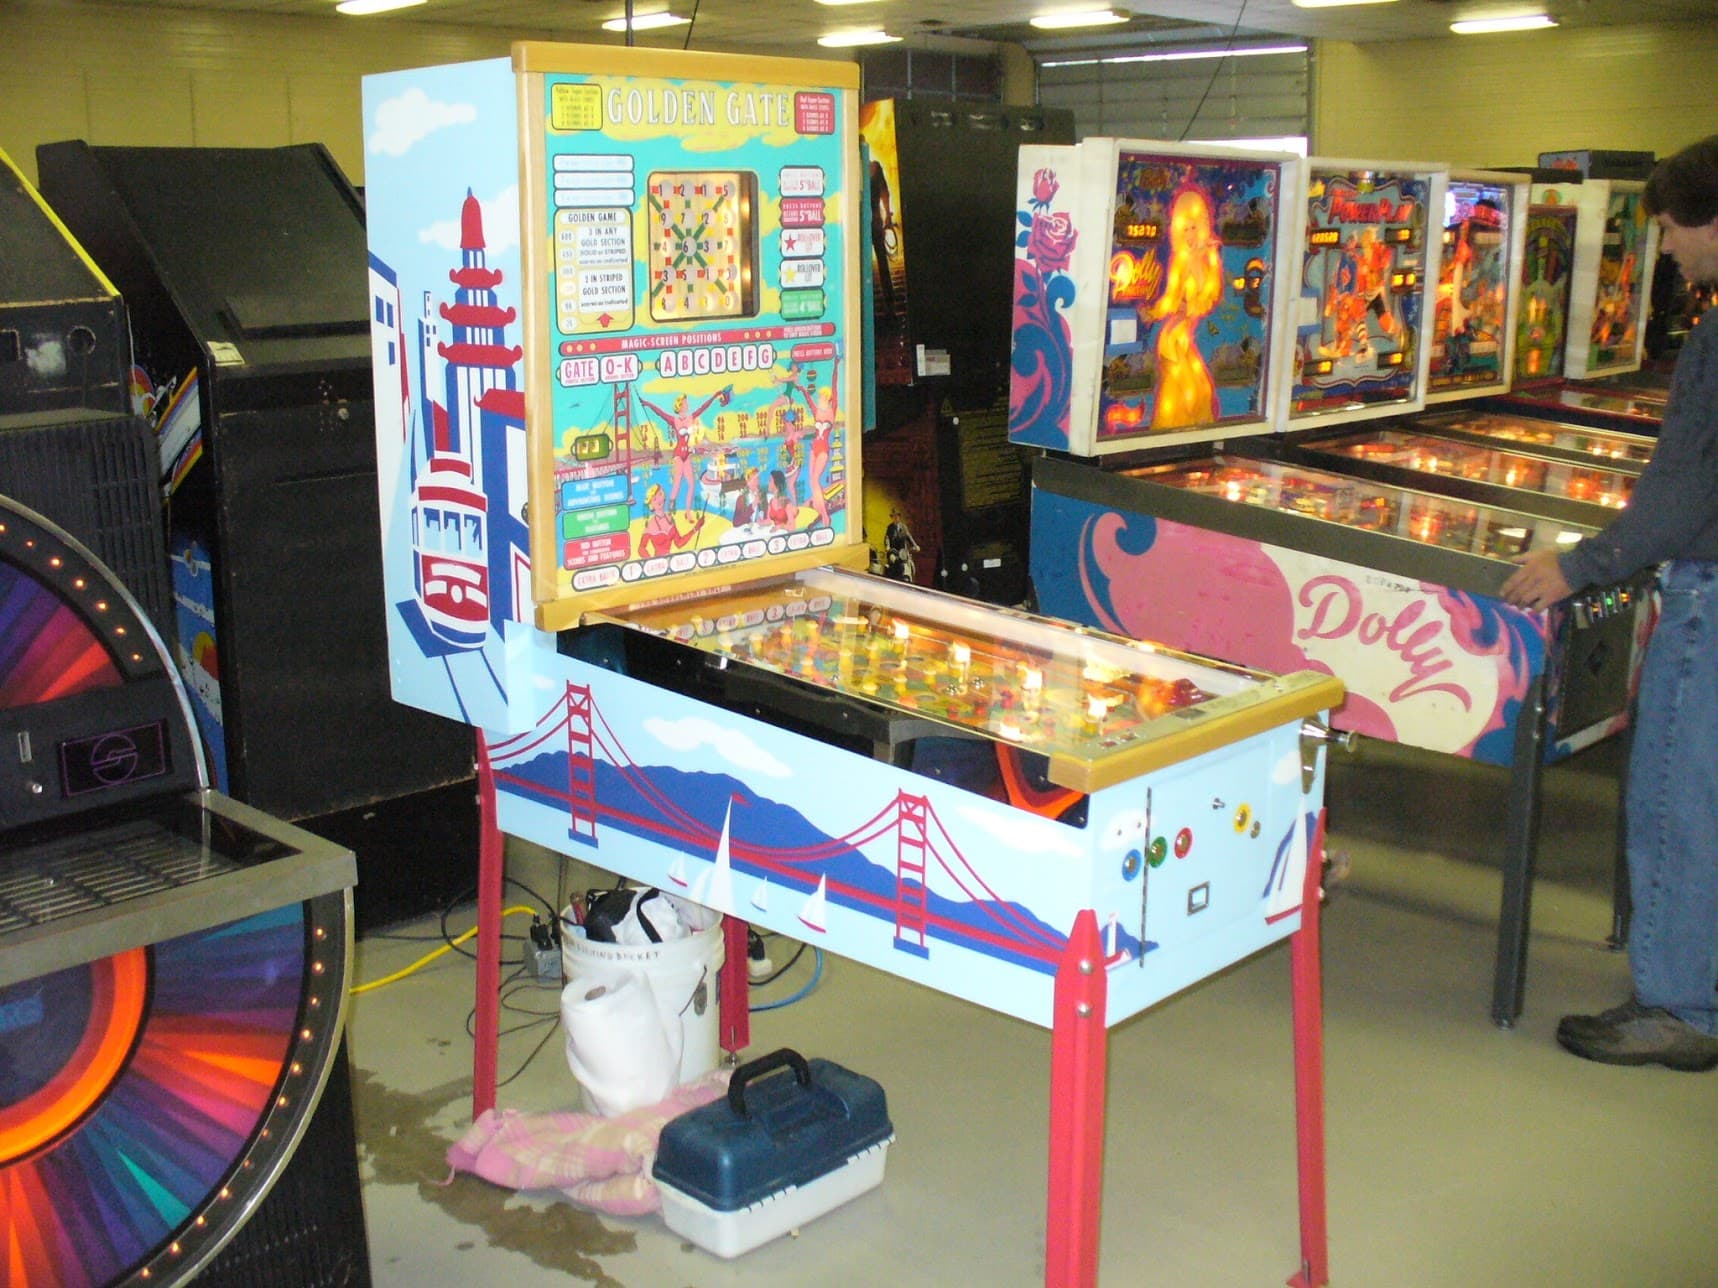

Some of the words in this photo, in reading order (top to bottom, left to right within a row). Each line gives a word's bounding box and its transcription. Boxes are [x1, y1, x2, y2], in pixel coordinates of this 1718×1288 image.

[607, 87, 715, 126] GOLDEN
[727, 91, 790, 127] GATE
[568, 213, 595, 223] GOLDEN
[598, 212, 617, 222] GAME
[601, 285, 626, 295] SECTION
[682, 332, 722, 345] POSITIONS
[682, 355, 688, 370] B
[698, 354, 705, 369] C
[715, 352, 722, 367] D
[732, 351, 737, 366] E
[748, 350, 753, 365] F
[762, 349, 769, 363] G
[565, 360, 594, 378] GATE
[664, 356, 672, 372] A
[1297, 574, 1472, 712] Dolly
